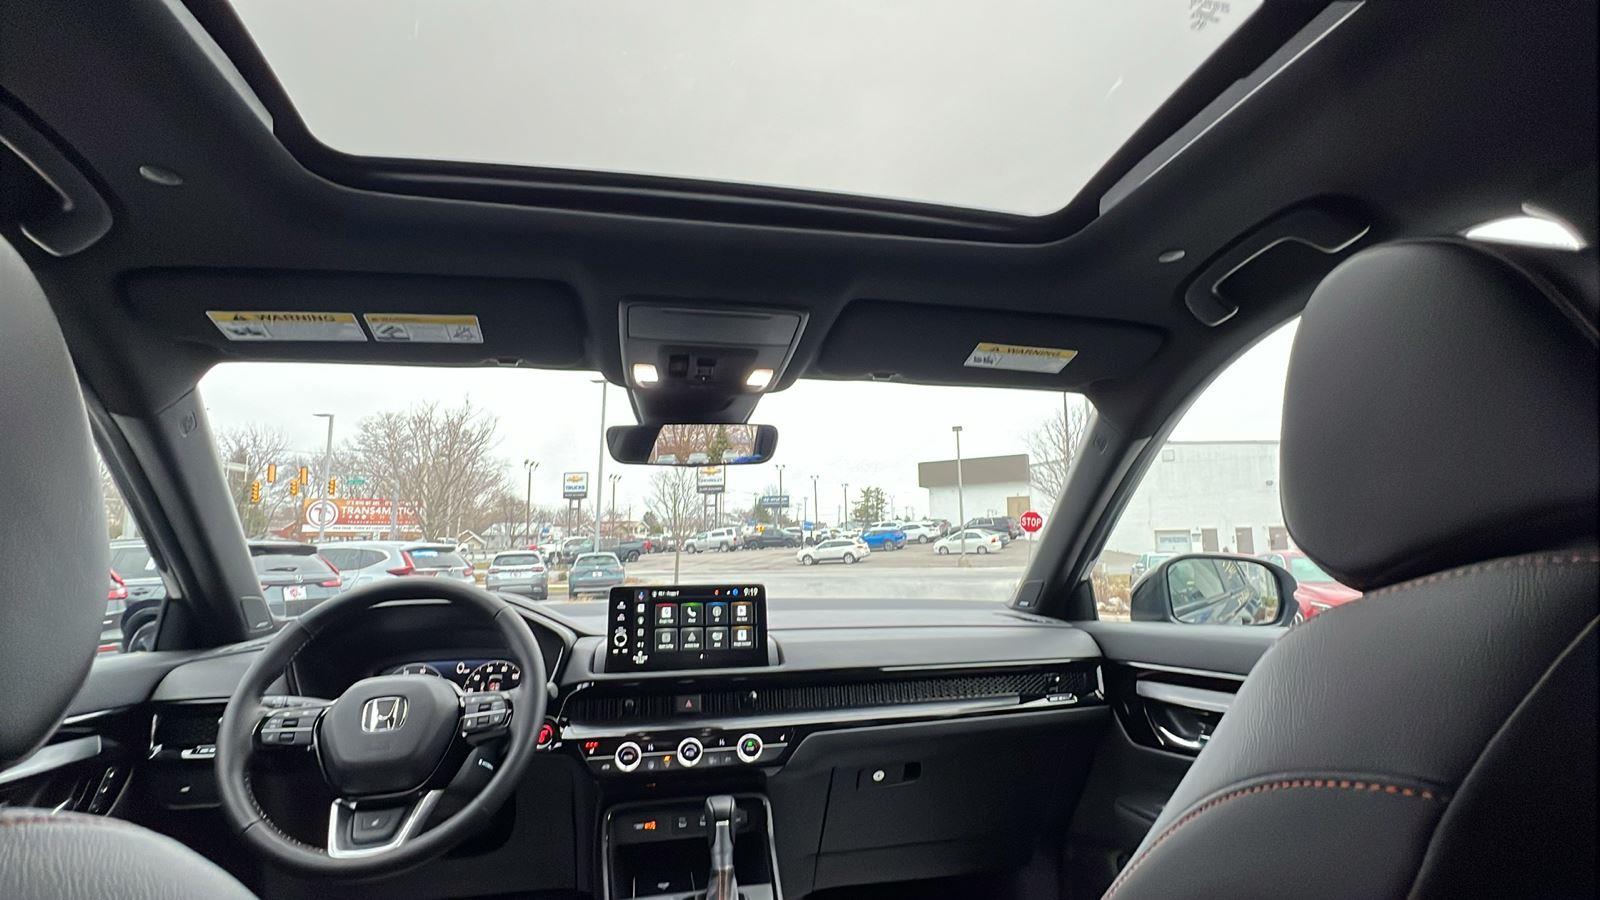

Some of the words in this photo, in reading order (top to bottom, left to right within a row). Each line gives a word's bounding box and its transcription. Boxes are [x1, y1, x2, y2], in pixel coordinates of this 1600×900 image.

[256, 313, 335, 322] WARNING
[341, 506, 424, 515] TRANS4MTION
[1021, 516, 1042, 527] STOP
[743, 587, 759, 597] 9:19
